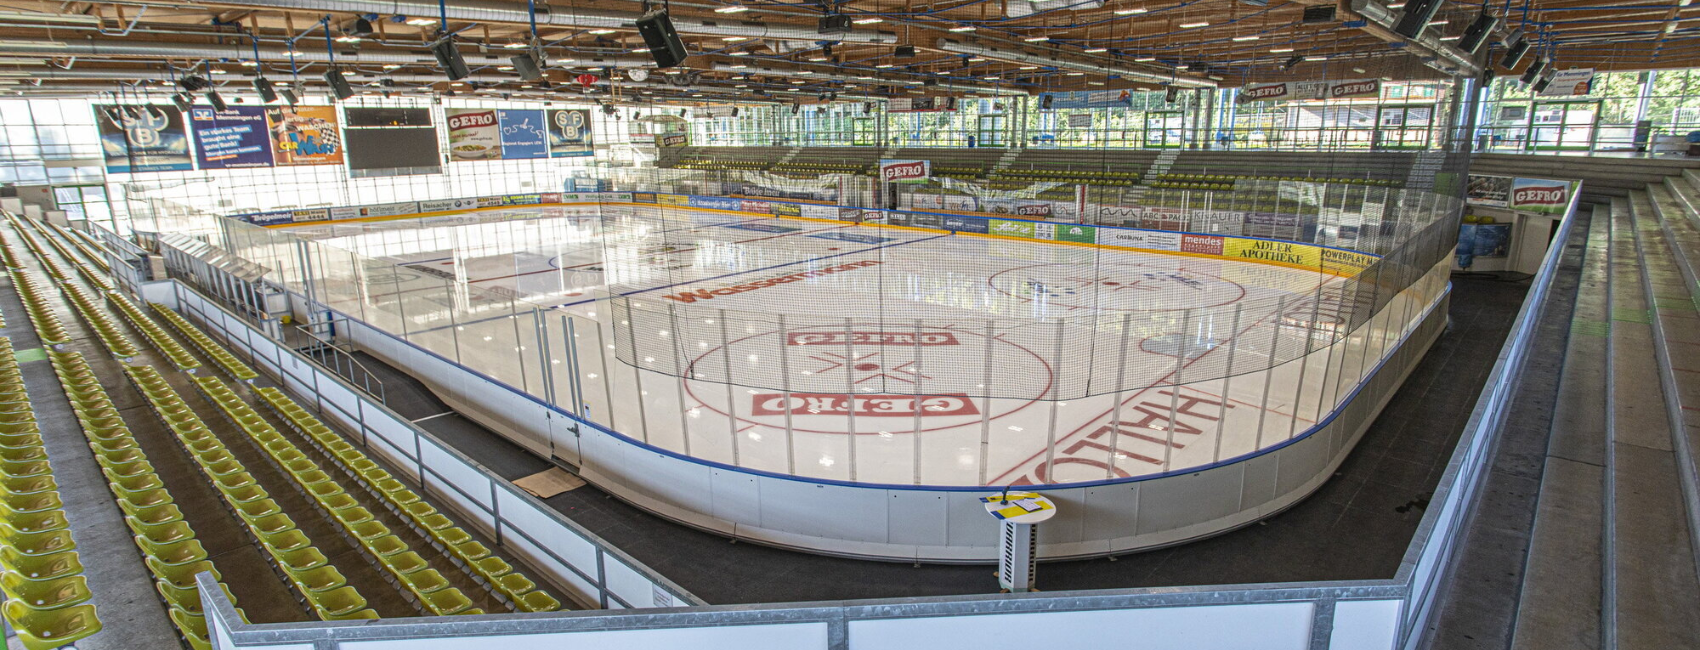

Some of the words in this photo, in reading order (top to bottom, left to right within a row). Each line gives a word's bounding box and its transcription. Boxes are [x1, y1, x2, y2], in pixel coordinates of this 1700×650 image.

[1249, 87, 1284, 99] GEFRO
[1334, 82, 1375, 97] GEFRO
[450, 114, 493, 129] GEFRO
[558, 114, 568, 125] S
[572, 114, 580, 125] F
[135, 128, 153, 144] B
[566, 126, 575, 137] B
[279, 142, 298, 150] CAR
[664, 137, 685, 146] GEFRO
[886, 164, 923, 181] GEFRO
[1516, 188, 1562, 202] GEFRO
[252, 212, 292, 223] Brögelmeir
[1019, 206, 1050, 217] GEFRO
[1194, 212, 1240, 222] KNAUER
[1184, 236, 1221, 246] mendes
[1252, 241, 1292, 253] ADLER
[1239, 251, 1303, 265] APOTHEKE
[1321, 249, 1366, 265] POWERPLAY
[797, 333, 951, 345] GEFRO
[762, 395, 969, 413] GEFRO
